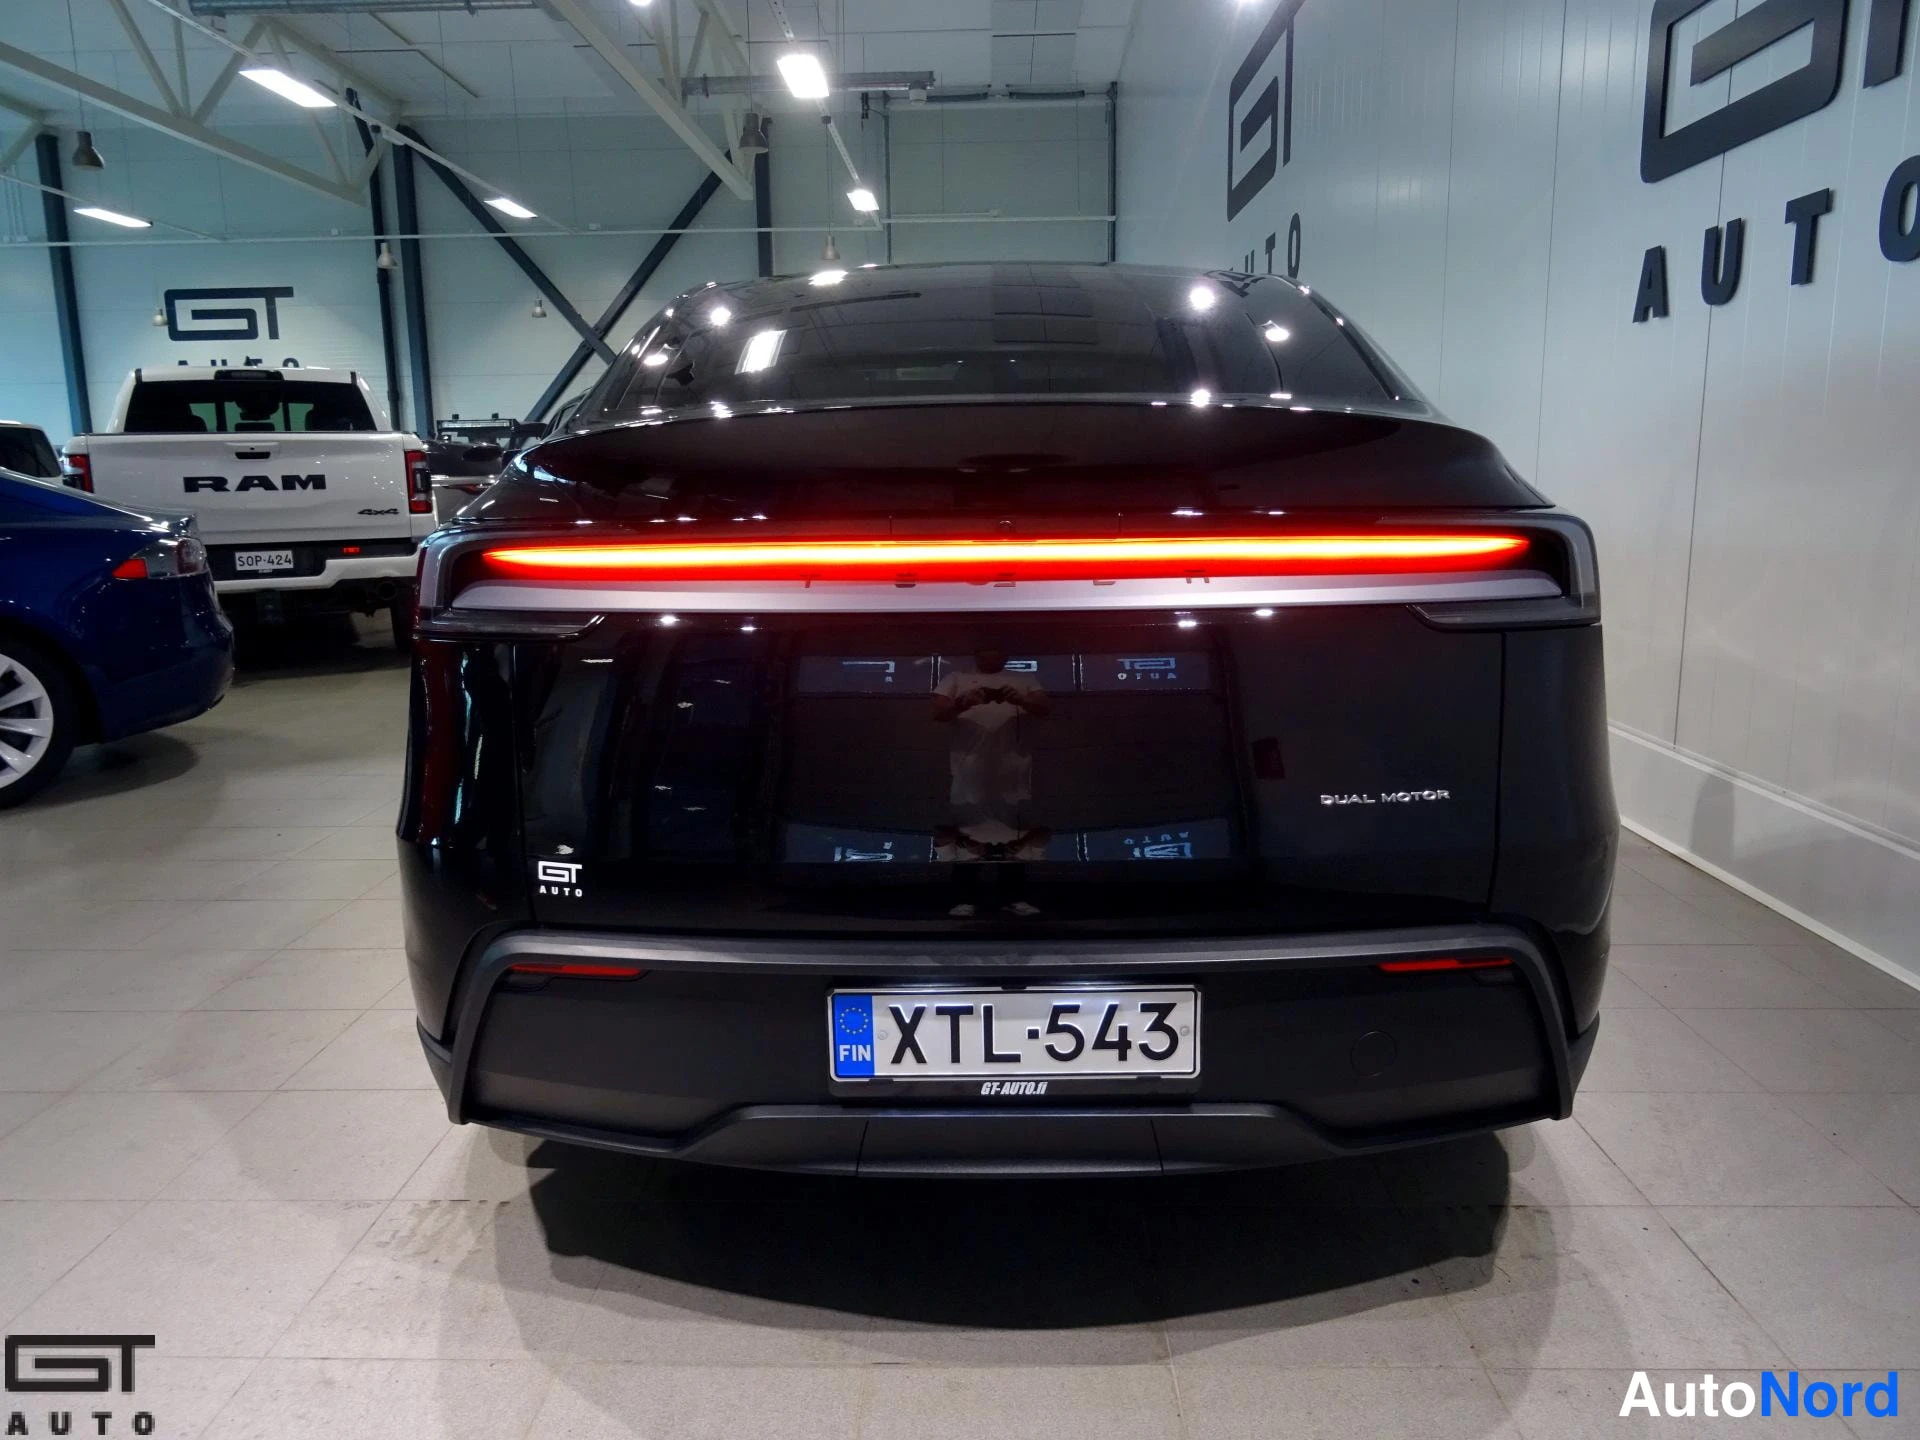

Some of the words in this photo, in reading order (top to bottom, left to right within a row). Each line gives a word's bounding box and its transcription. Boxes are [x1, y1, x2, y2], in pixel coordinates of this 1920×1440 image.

[164, 286, 294, 341] GT
[183, 474, 327, 493] RAM
[357, 508, 400, 516] 4x4
[1320, 794, 1376, 804] DUAL
[1381, 789, 1450, 803] MOTOR
[538, 860, 583, 884] GT
[539, 885, 583, 897] AUTO
[839, 1044, 872, 1062] FIN
